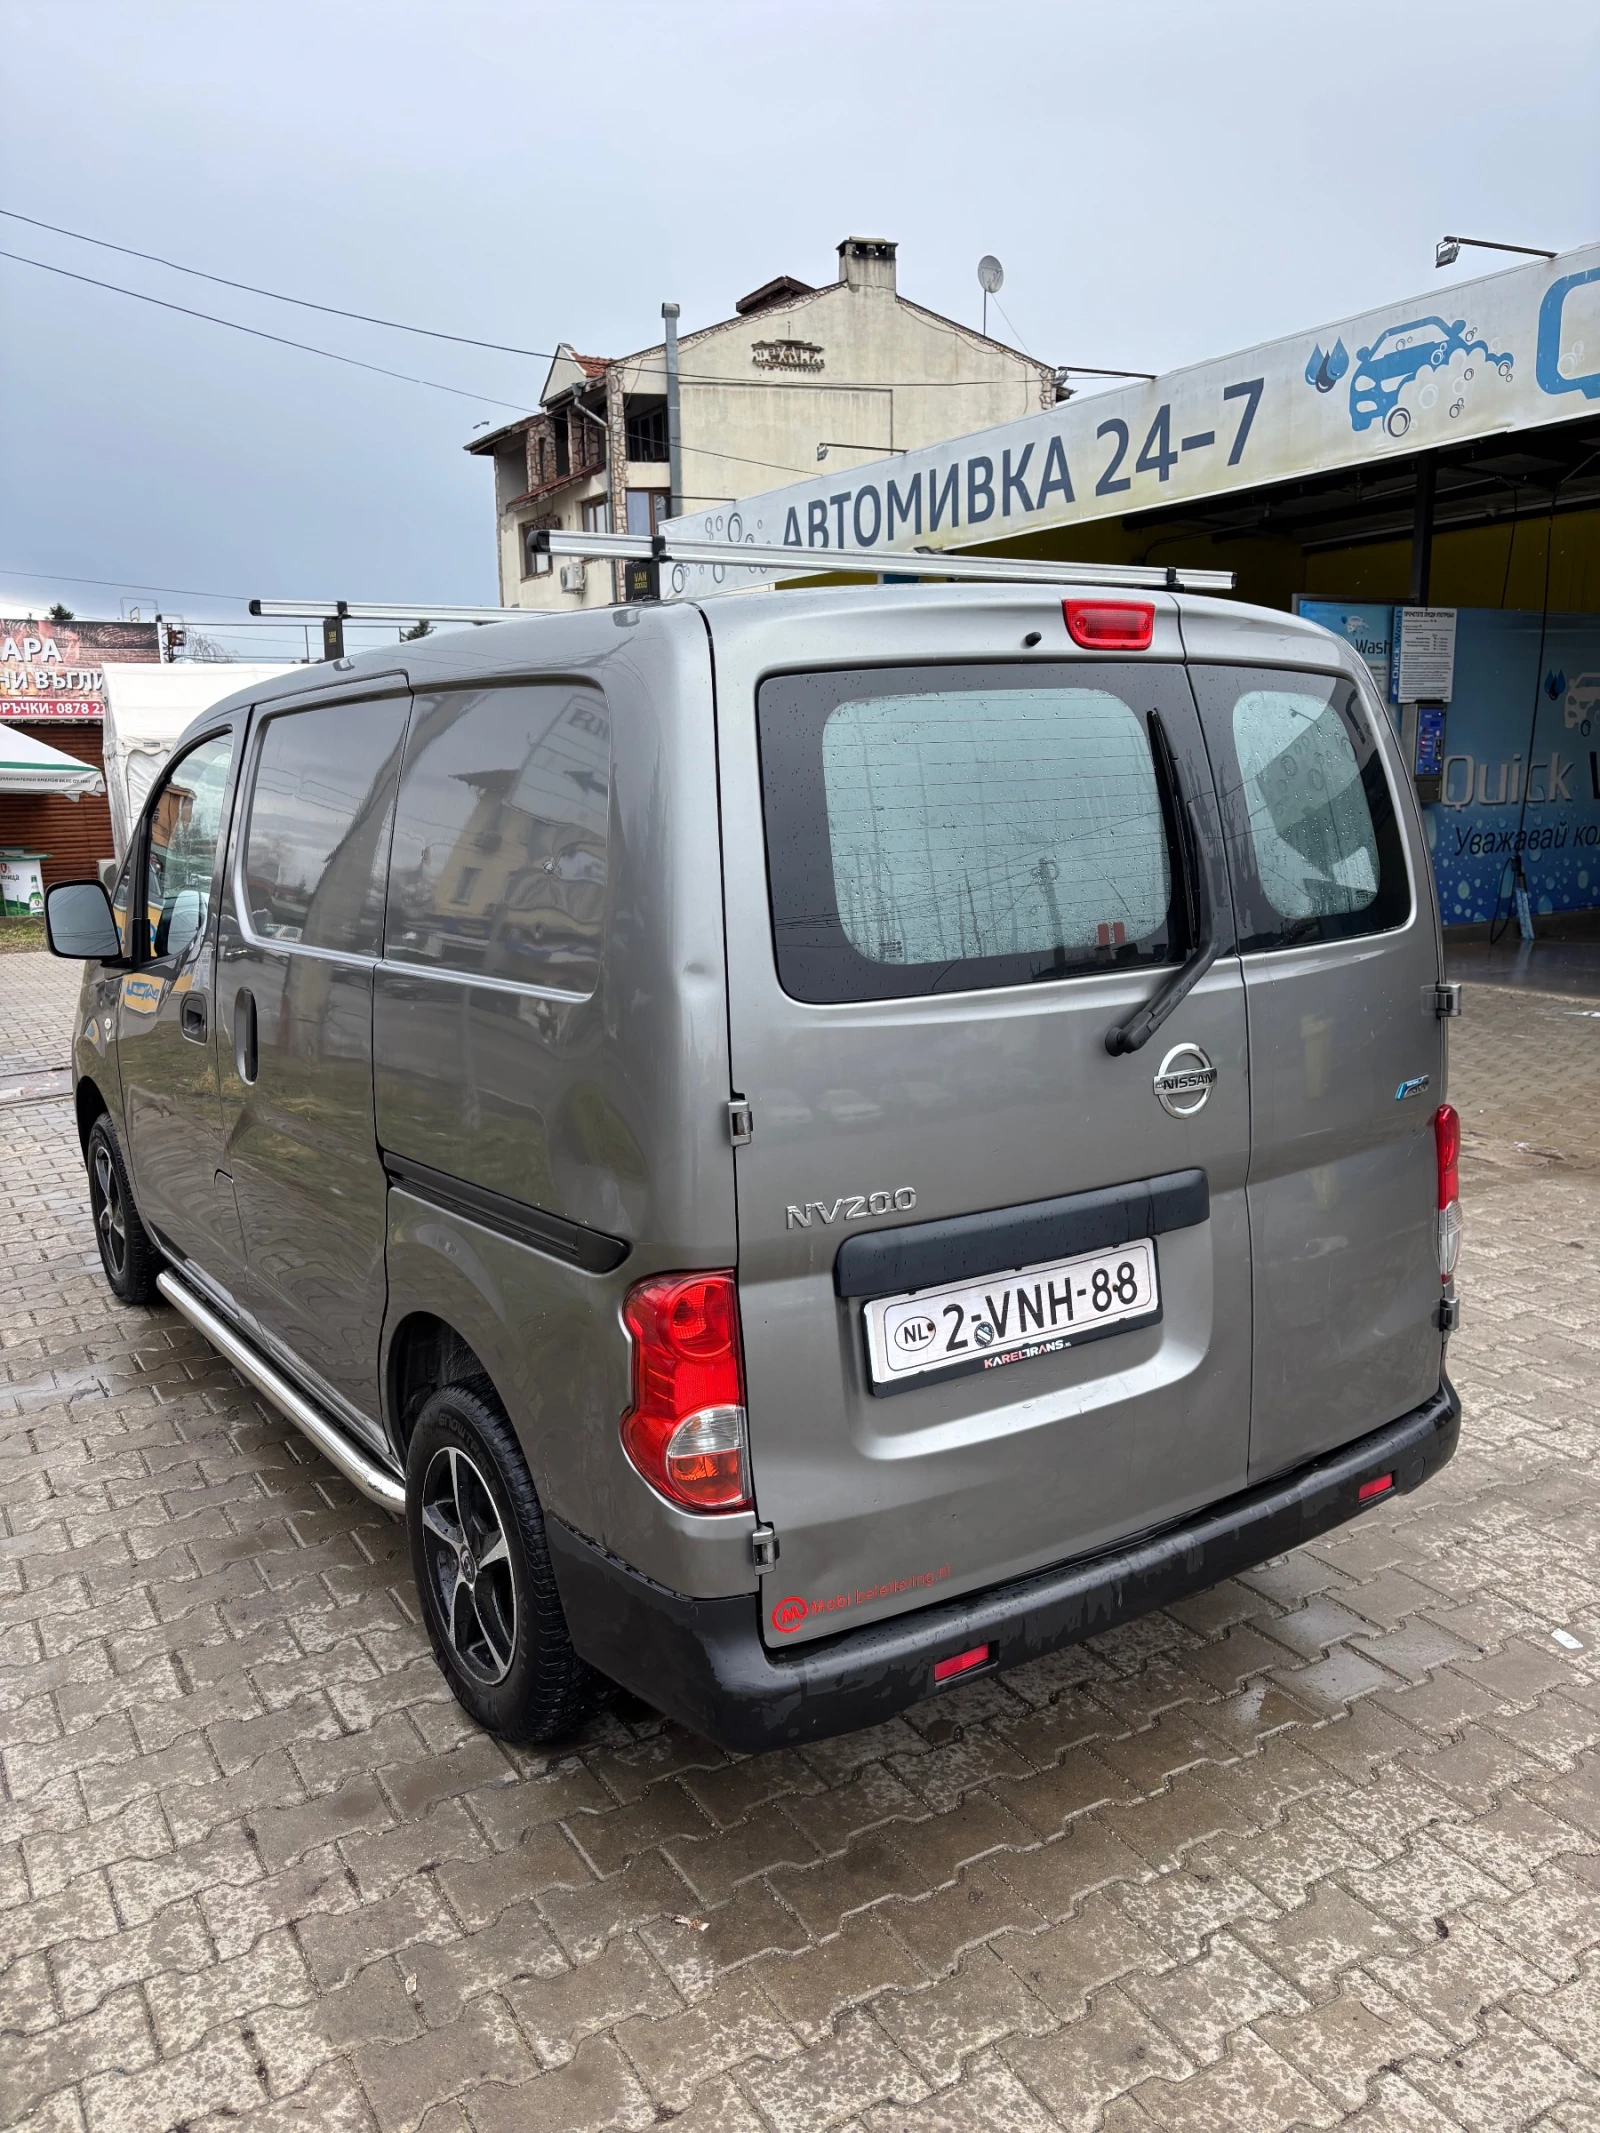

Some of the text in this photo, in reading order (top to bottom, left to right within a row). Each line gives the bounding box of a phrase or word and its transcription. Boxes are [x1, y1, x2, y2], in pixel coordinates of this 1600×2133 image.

[782, 377, 1266, 548] АВТОМИВКА 24-7
[0, 702, 54, 715] РЪЧКИ:
[56, 702, 89, 714] 0878
[1441, 752, 1574, 813] Quick
[1454, 821, 1568, 857] Уважавай
[1163, 1072, 1214, 1091] NISSAN
[785, 1186, 918, 1231] NV200
[904, 1324, 930, 1345] NL
[942, 1261, 1139, 1353] 2-VNH-88
